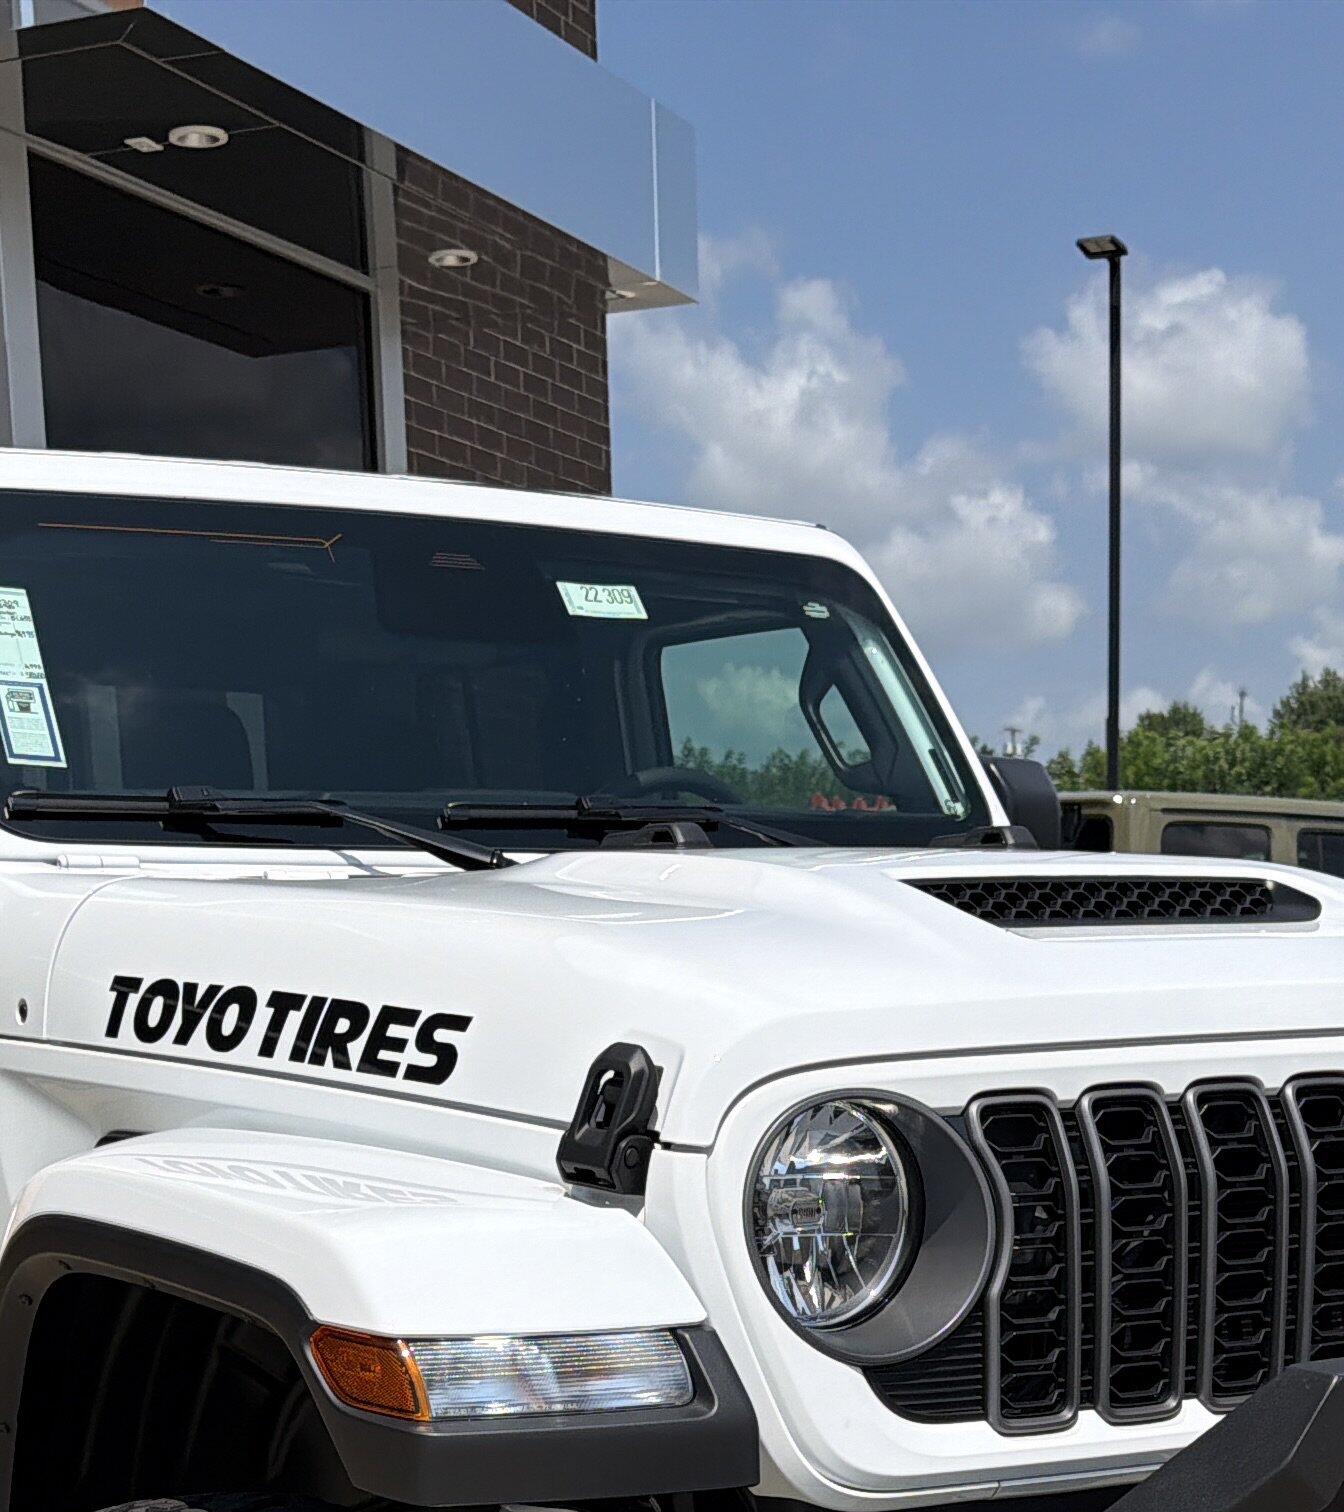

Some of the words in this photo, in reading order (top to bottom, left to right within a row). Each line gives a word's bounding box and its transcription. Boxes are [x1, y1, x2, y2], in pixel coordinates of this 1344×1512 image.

[579, 585, 635, 606] 22309
[104, 974, 258, 1054] TOYO
[256, 989, 475, 1086] TIRES
